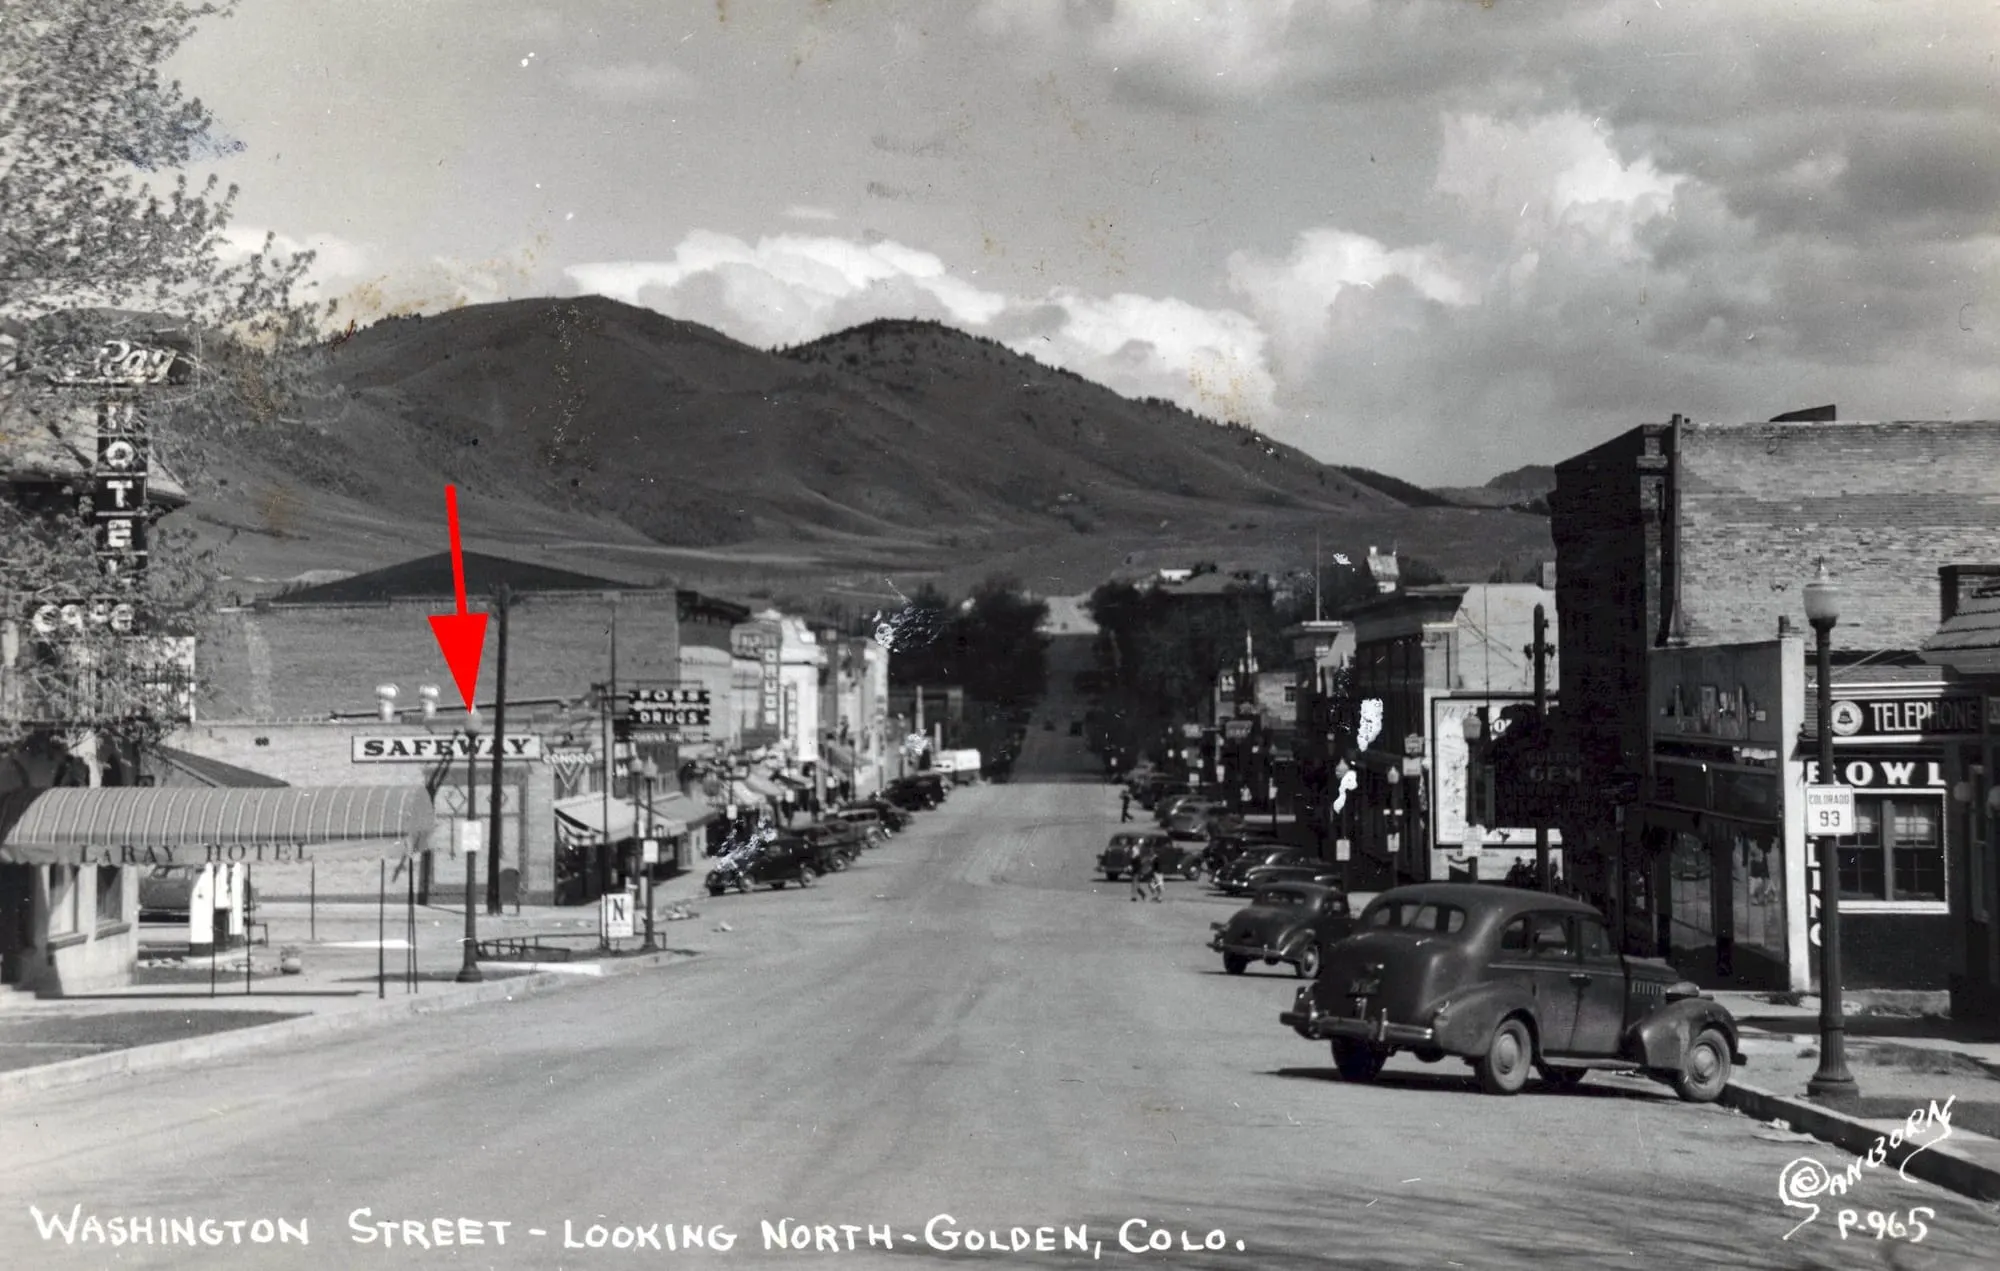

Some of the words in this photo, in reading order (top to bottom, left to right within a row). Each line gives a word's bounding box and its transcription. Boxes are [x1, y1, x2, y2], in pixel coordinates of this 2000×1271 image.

[639, 711, 699, 724] DRUGS
[1868, 701, 1978, 732] TELEPHONE
[542, 752, 596, 764] CONOCO
[1808, 793, 1850, 806] COLORADO
[1819, 810, 1841, 827] 93
[205, 843, 314, 863] HOTEL
